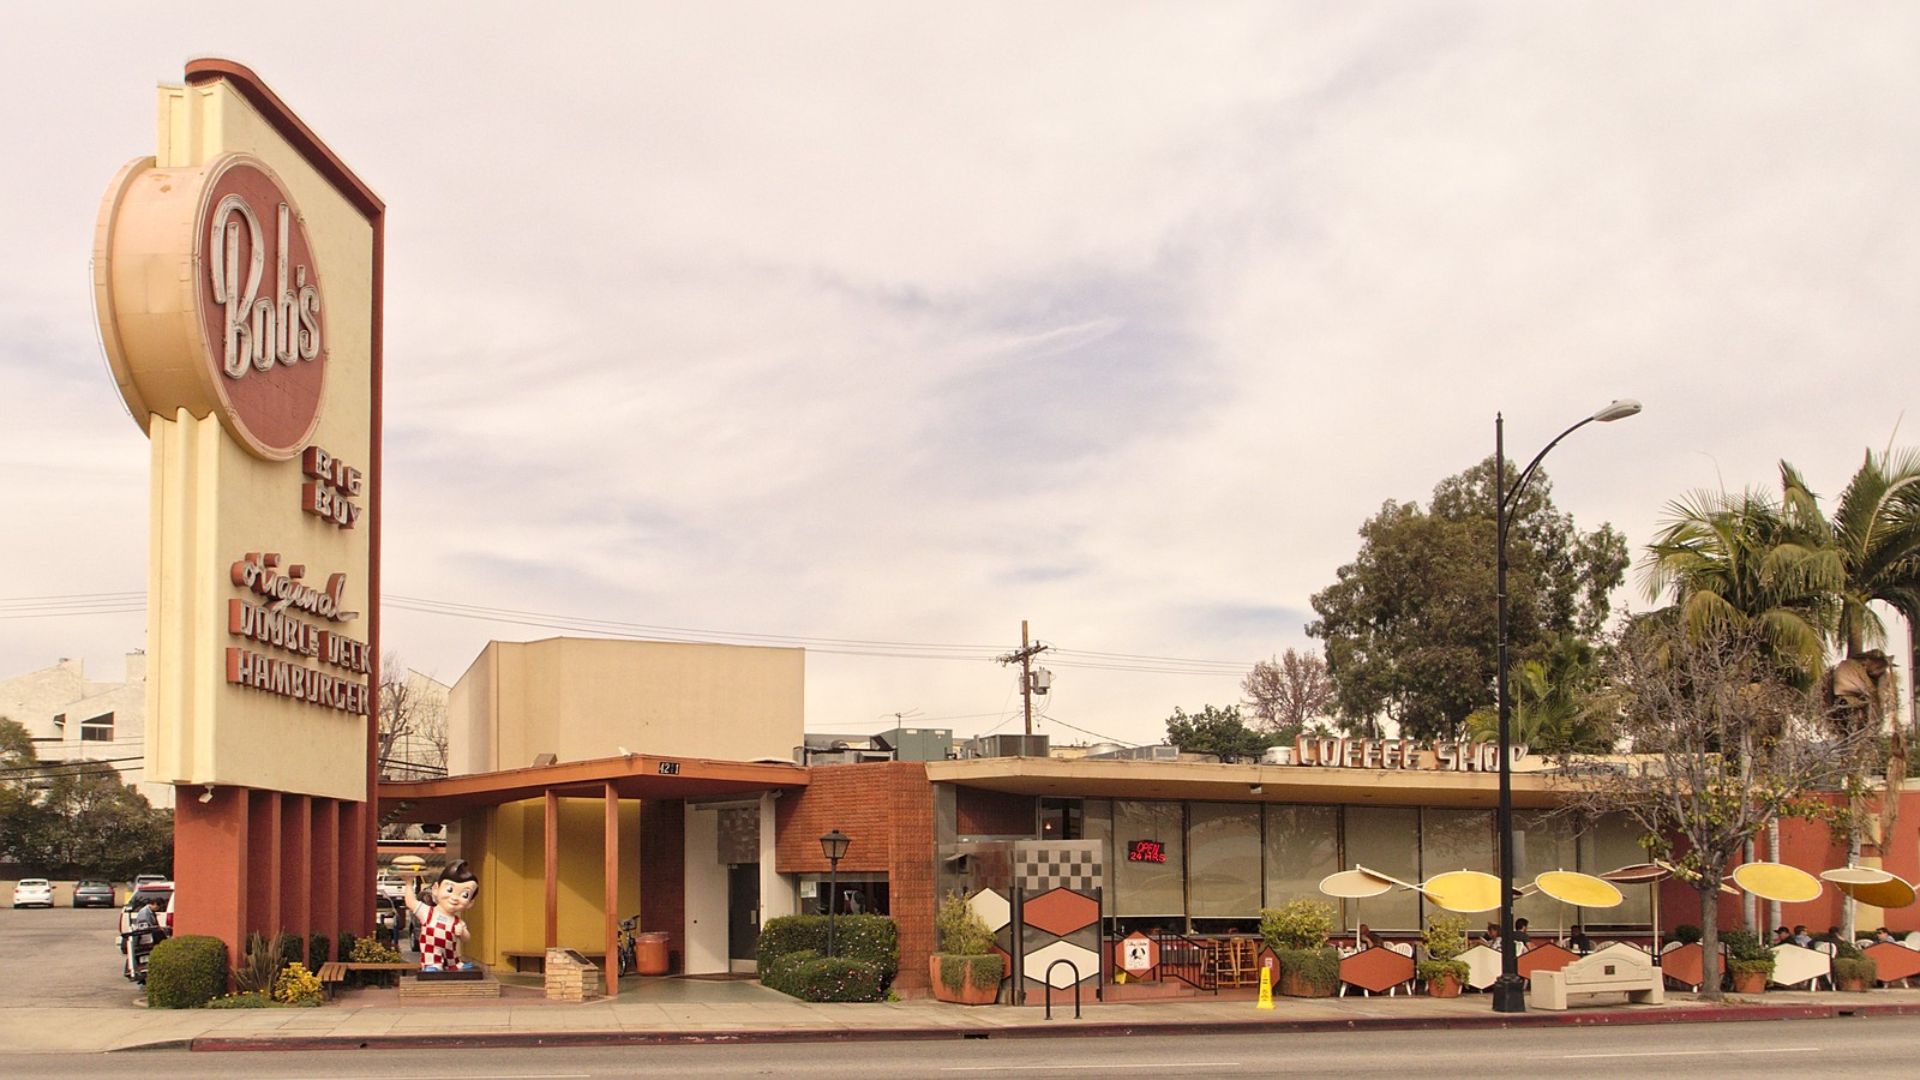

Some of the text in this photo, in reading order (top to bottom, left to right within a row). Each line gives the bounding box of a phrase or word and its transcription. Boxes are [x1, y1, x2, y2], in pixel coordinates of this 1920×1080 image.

[210, 194, 320, 379] Bob's
[312, 446, 362, 497] BIG
[311, 482, 362, 529] BOY
[236, 600, 373, 674] DOUBLE DECK
[234, 648, 371, 716] HAMBURGER
[1297, 735, 1529, 772] COFFEE SHOP
[1130, 852, 1167, 863] 24 HRS
[1136, 842, 1160, 853] OPEN
